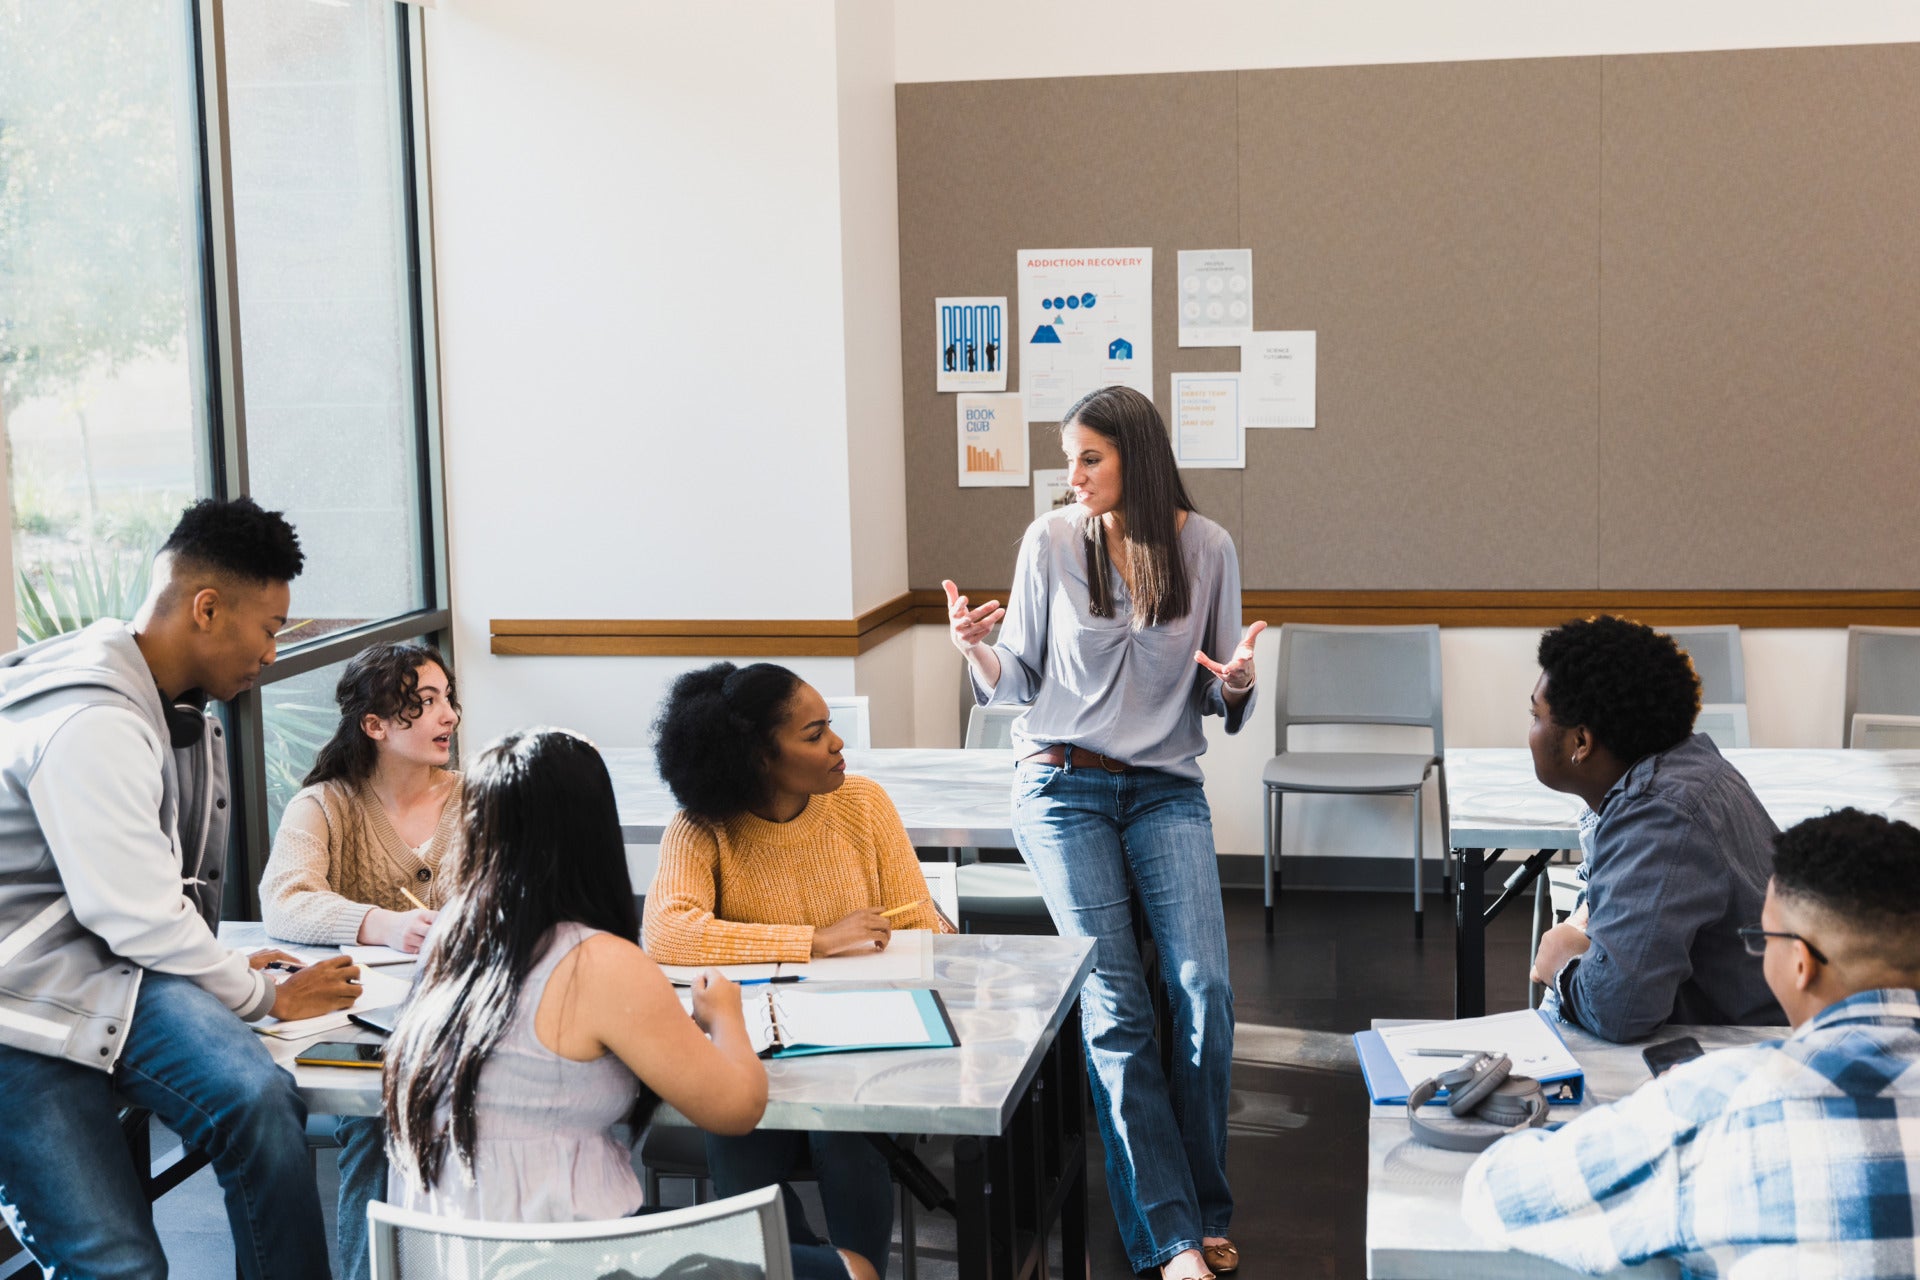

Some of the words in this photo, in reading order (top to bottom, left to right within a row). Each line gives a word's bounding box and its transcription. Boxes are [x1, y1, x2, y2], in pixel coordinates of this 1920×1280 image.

[1027, 259, 1085, 267] ADDICTION
[1087, 258, 1143, 266] RECOVERY
[966, 409, 995, 420] BOOK
[966, 421, 990, 432] CLUB
